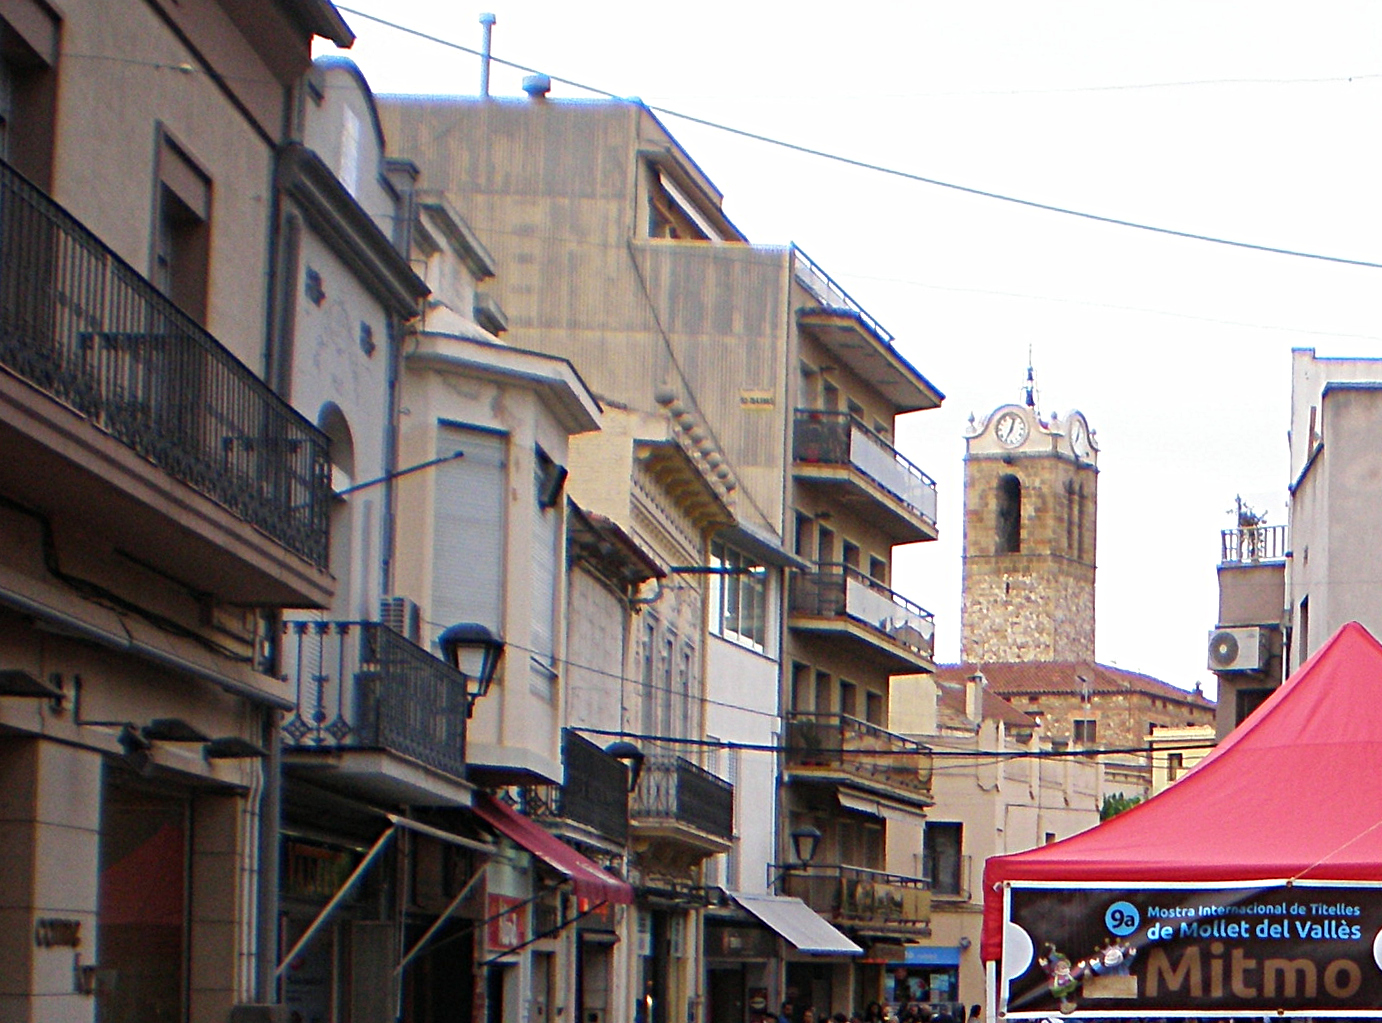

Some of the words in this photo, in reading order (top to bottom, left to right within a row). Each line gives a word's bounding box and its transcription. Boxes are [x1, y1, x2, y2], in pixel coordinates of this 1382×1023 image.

[1110, 909, 1136, 929] 9a
[1147, 906, 1196, 918] Mostra
[1198, 902, 1287, 917] Internacional
[1289, 902, 1307, 916] de
[1309, 902, 1361, 916] Titelles
[1146, 921, 1174, 940] de
[1180, 919, 1250, 939] Mollet
[1255, 918, 1290, 939] del
[1295, 918, 1362, 940] Vallès
[1145, 942, 1363, 1000] Mitmo
